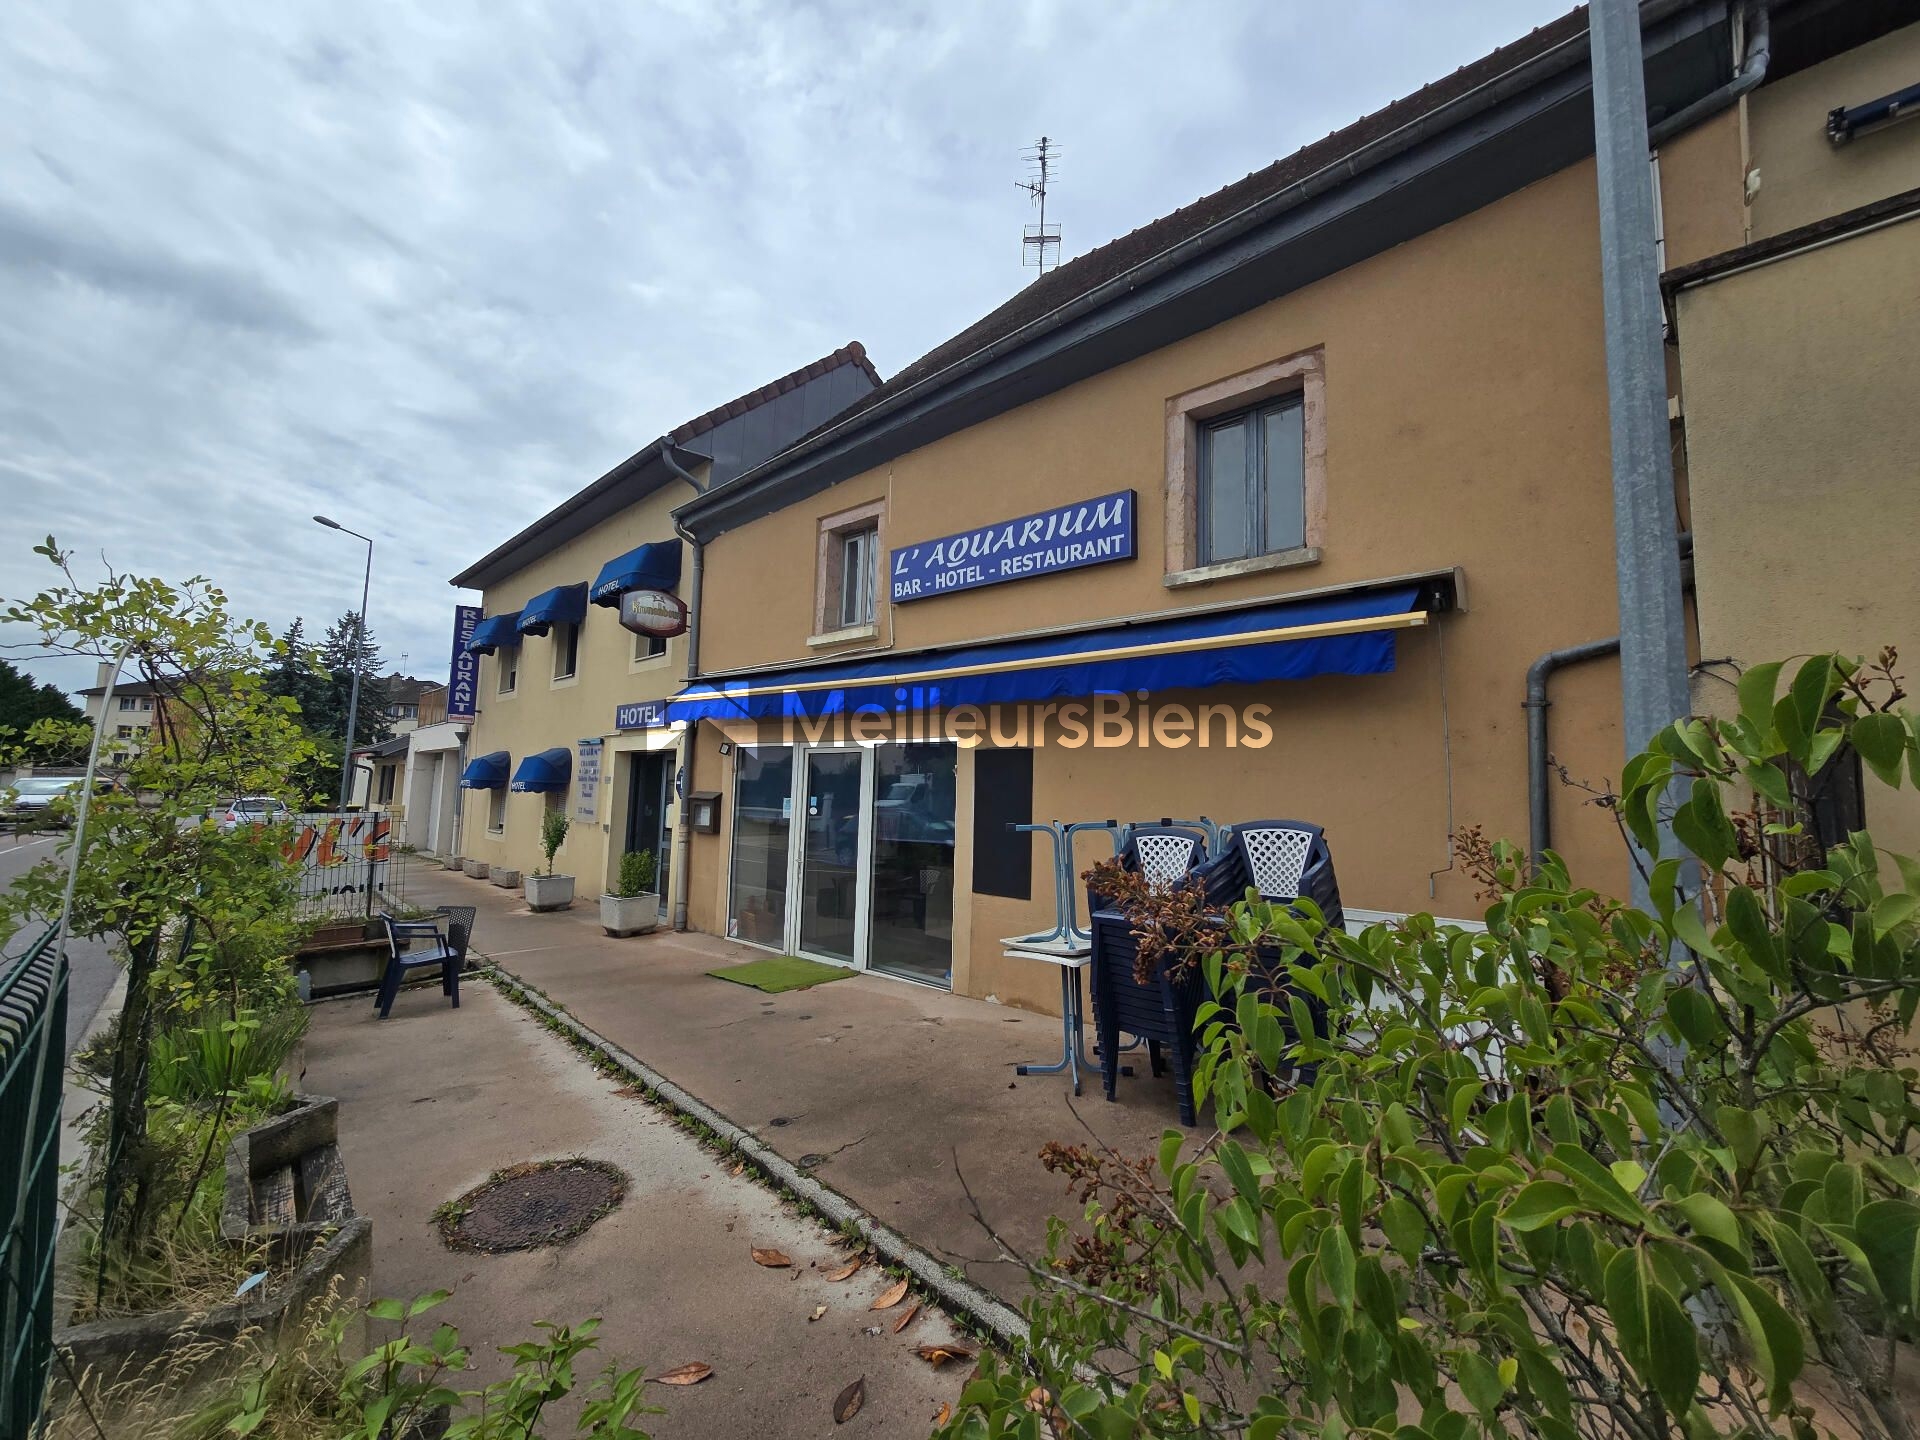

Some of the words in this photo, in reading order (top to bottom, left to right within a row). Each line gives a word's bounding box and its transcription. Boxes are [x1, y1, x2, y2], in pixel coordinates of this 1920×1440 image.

[925, 498, 1125, 568] AQUARIUM
[598, 579, 620, 595] HOTEL
[894, 578, 922, 597] BAR
[935, 565, 985, 589] HOTEL
[1000, 534, 1125, 576] RESTAURANT
[455, 609, 477, 712] RESTAURANT
[620, 705, 660, 725] HOTEL
